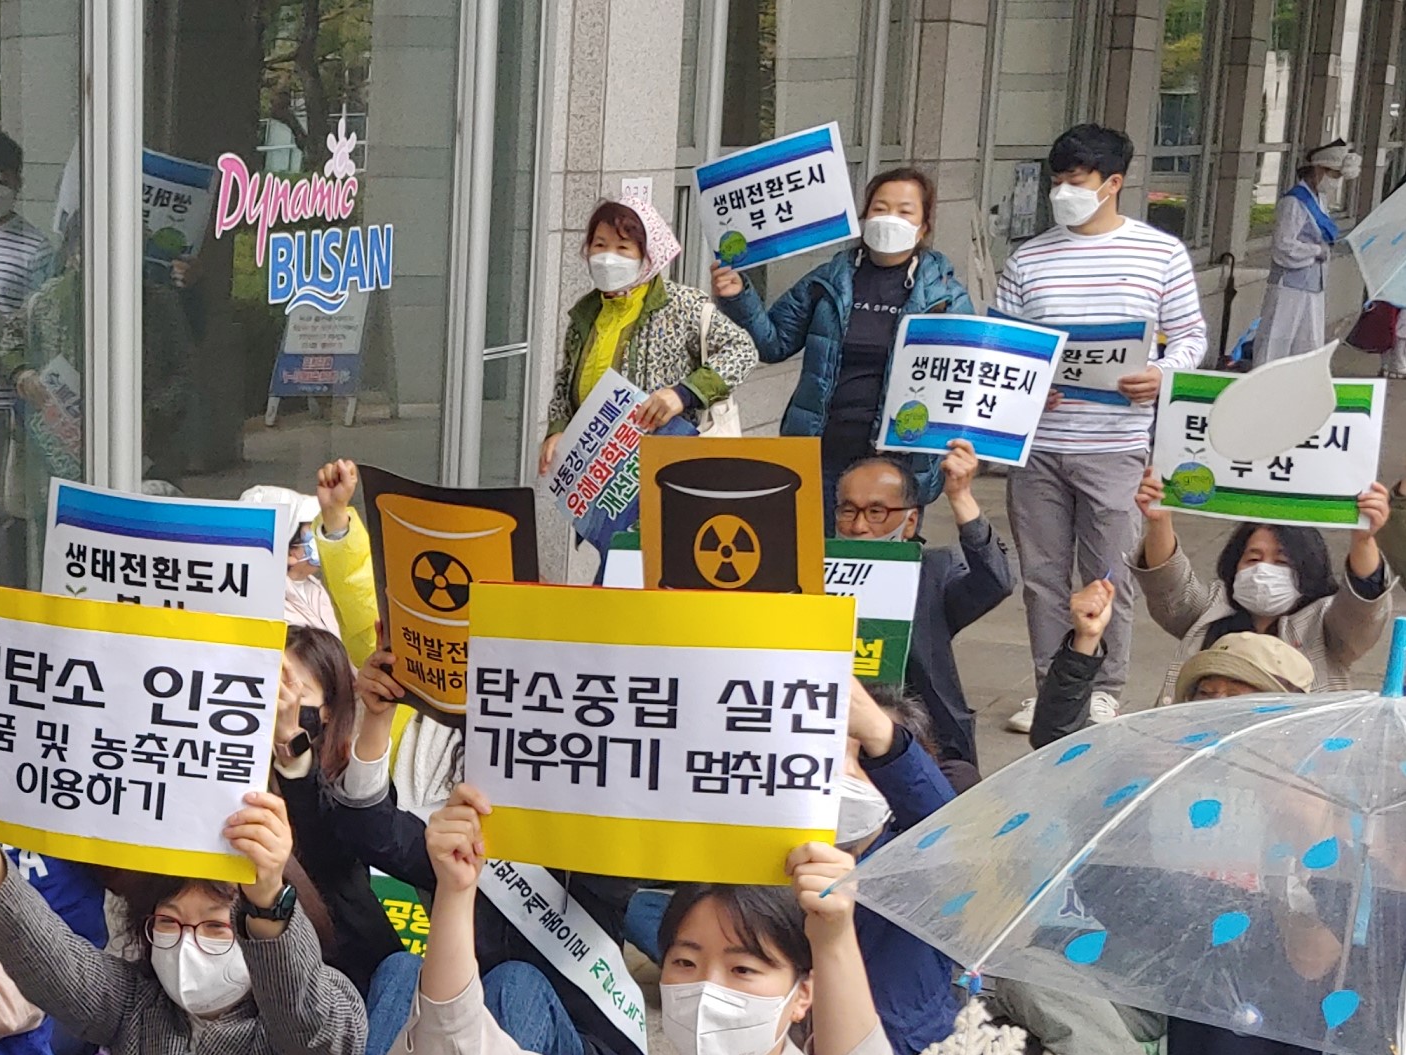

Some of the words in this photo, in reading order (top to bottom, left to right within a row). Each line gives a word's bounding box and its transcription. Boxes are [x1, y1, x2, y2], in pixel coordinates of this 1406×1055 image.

[215, 152, 358, 267] Dynamic
[713, 163, 826, 217] 생태전환도시
[267, 224, 394, 304] BUSAN
[912, 356, 1037, 394] 생태전환도시
[549, 450, 584, 497] 낙동강
[579, 388, 632, 454] 산업폐수
[65, 542, 250, 598] 생태전환도시
[143, 665, 267, 737] 인증
[475, 667, 679, 731] 탄소중립
[717, 677, 839, 736] 실천
[37, 722, 69, 762] 및
[91, 727, 256, 785] 농축산물
[475, 726, 661, 791] 기후위기
[686, 750, 833, 797] 멈춰요!
[16, 760, 167, 822] 이용하기
